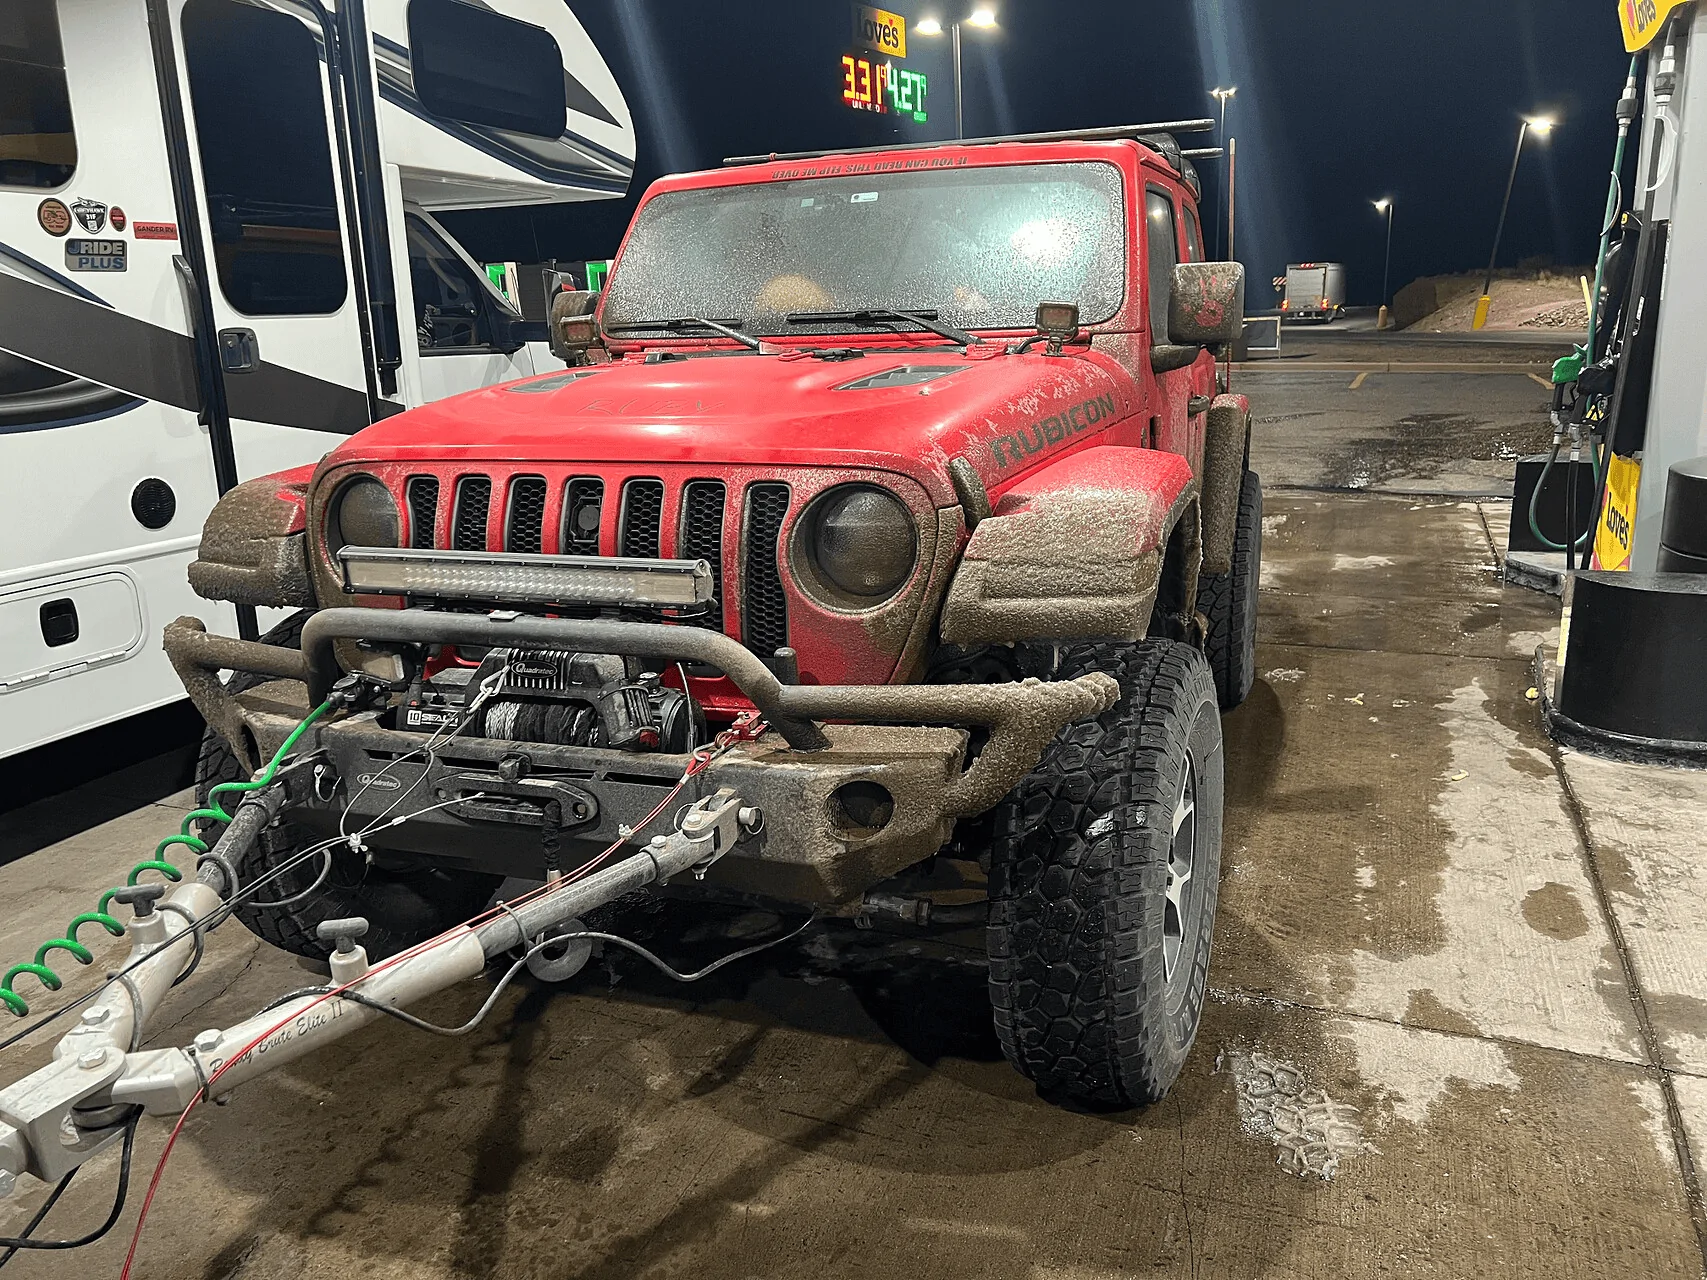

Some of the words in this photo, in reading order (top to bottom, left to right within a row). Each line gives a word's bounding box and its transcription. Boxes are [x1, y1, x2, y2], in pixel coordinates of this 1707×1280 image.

[873, 160, 903, 171] READ
[905, 159, 929, 169] CAN
[931, 157, 954, 167] YOU
[801, 167, 818, 177] ME
[819, 165, 842, 175] FLIP
[136, 225, 165, 233] GANDER
[78, 256, 124, 269] PLUS
[990, 392, 1115, 468] RUBICON
[296, 1014, 327, 1036] Elite
